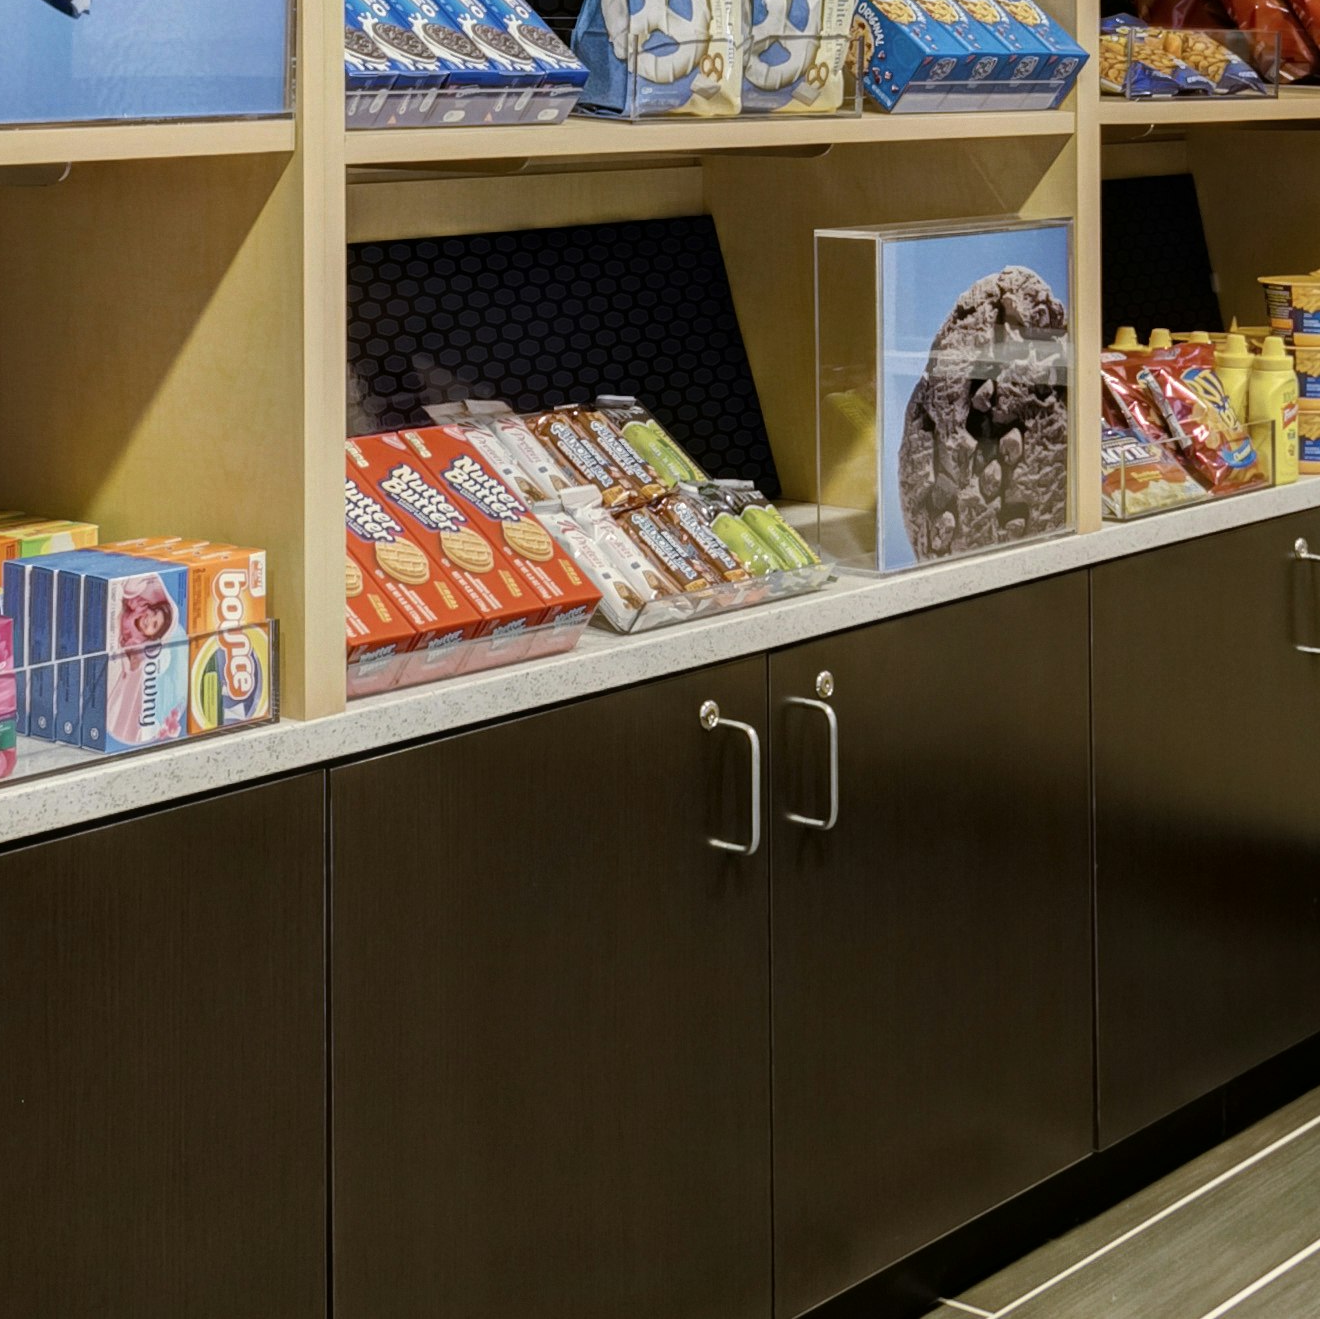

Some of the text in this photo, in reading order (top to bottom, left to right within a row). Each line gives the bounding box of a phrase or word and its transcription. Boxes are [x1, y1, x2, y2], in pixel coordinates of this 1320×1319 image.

[857, 2, 885, 47] ORIGINAL
[454, 454, 528, 514] Nutter
[551, 422, 614, 488] GRANOLA BAR
[557, 440, 596, 480] CHOCOLATE
[345, 479, 403, 533] utter
[345, 500, 396, 543] utter
[381, 475, 461, 533] Butter
[391, 463, 468, 523] Nutter
[443, 467, 520, 523] Butter
[217, 569, 254, 694] bounce
[138, 642, 165, 728] Downy
